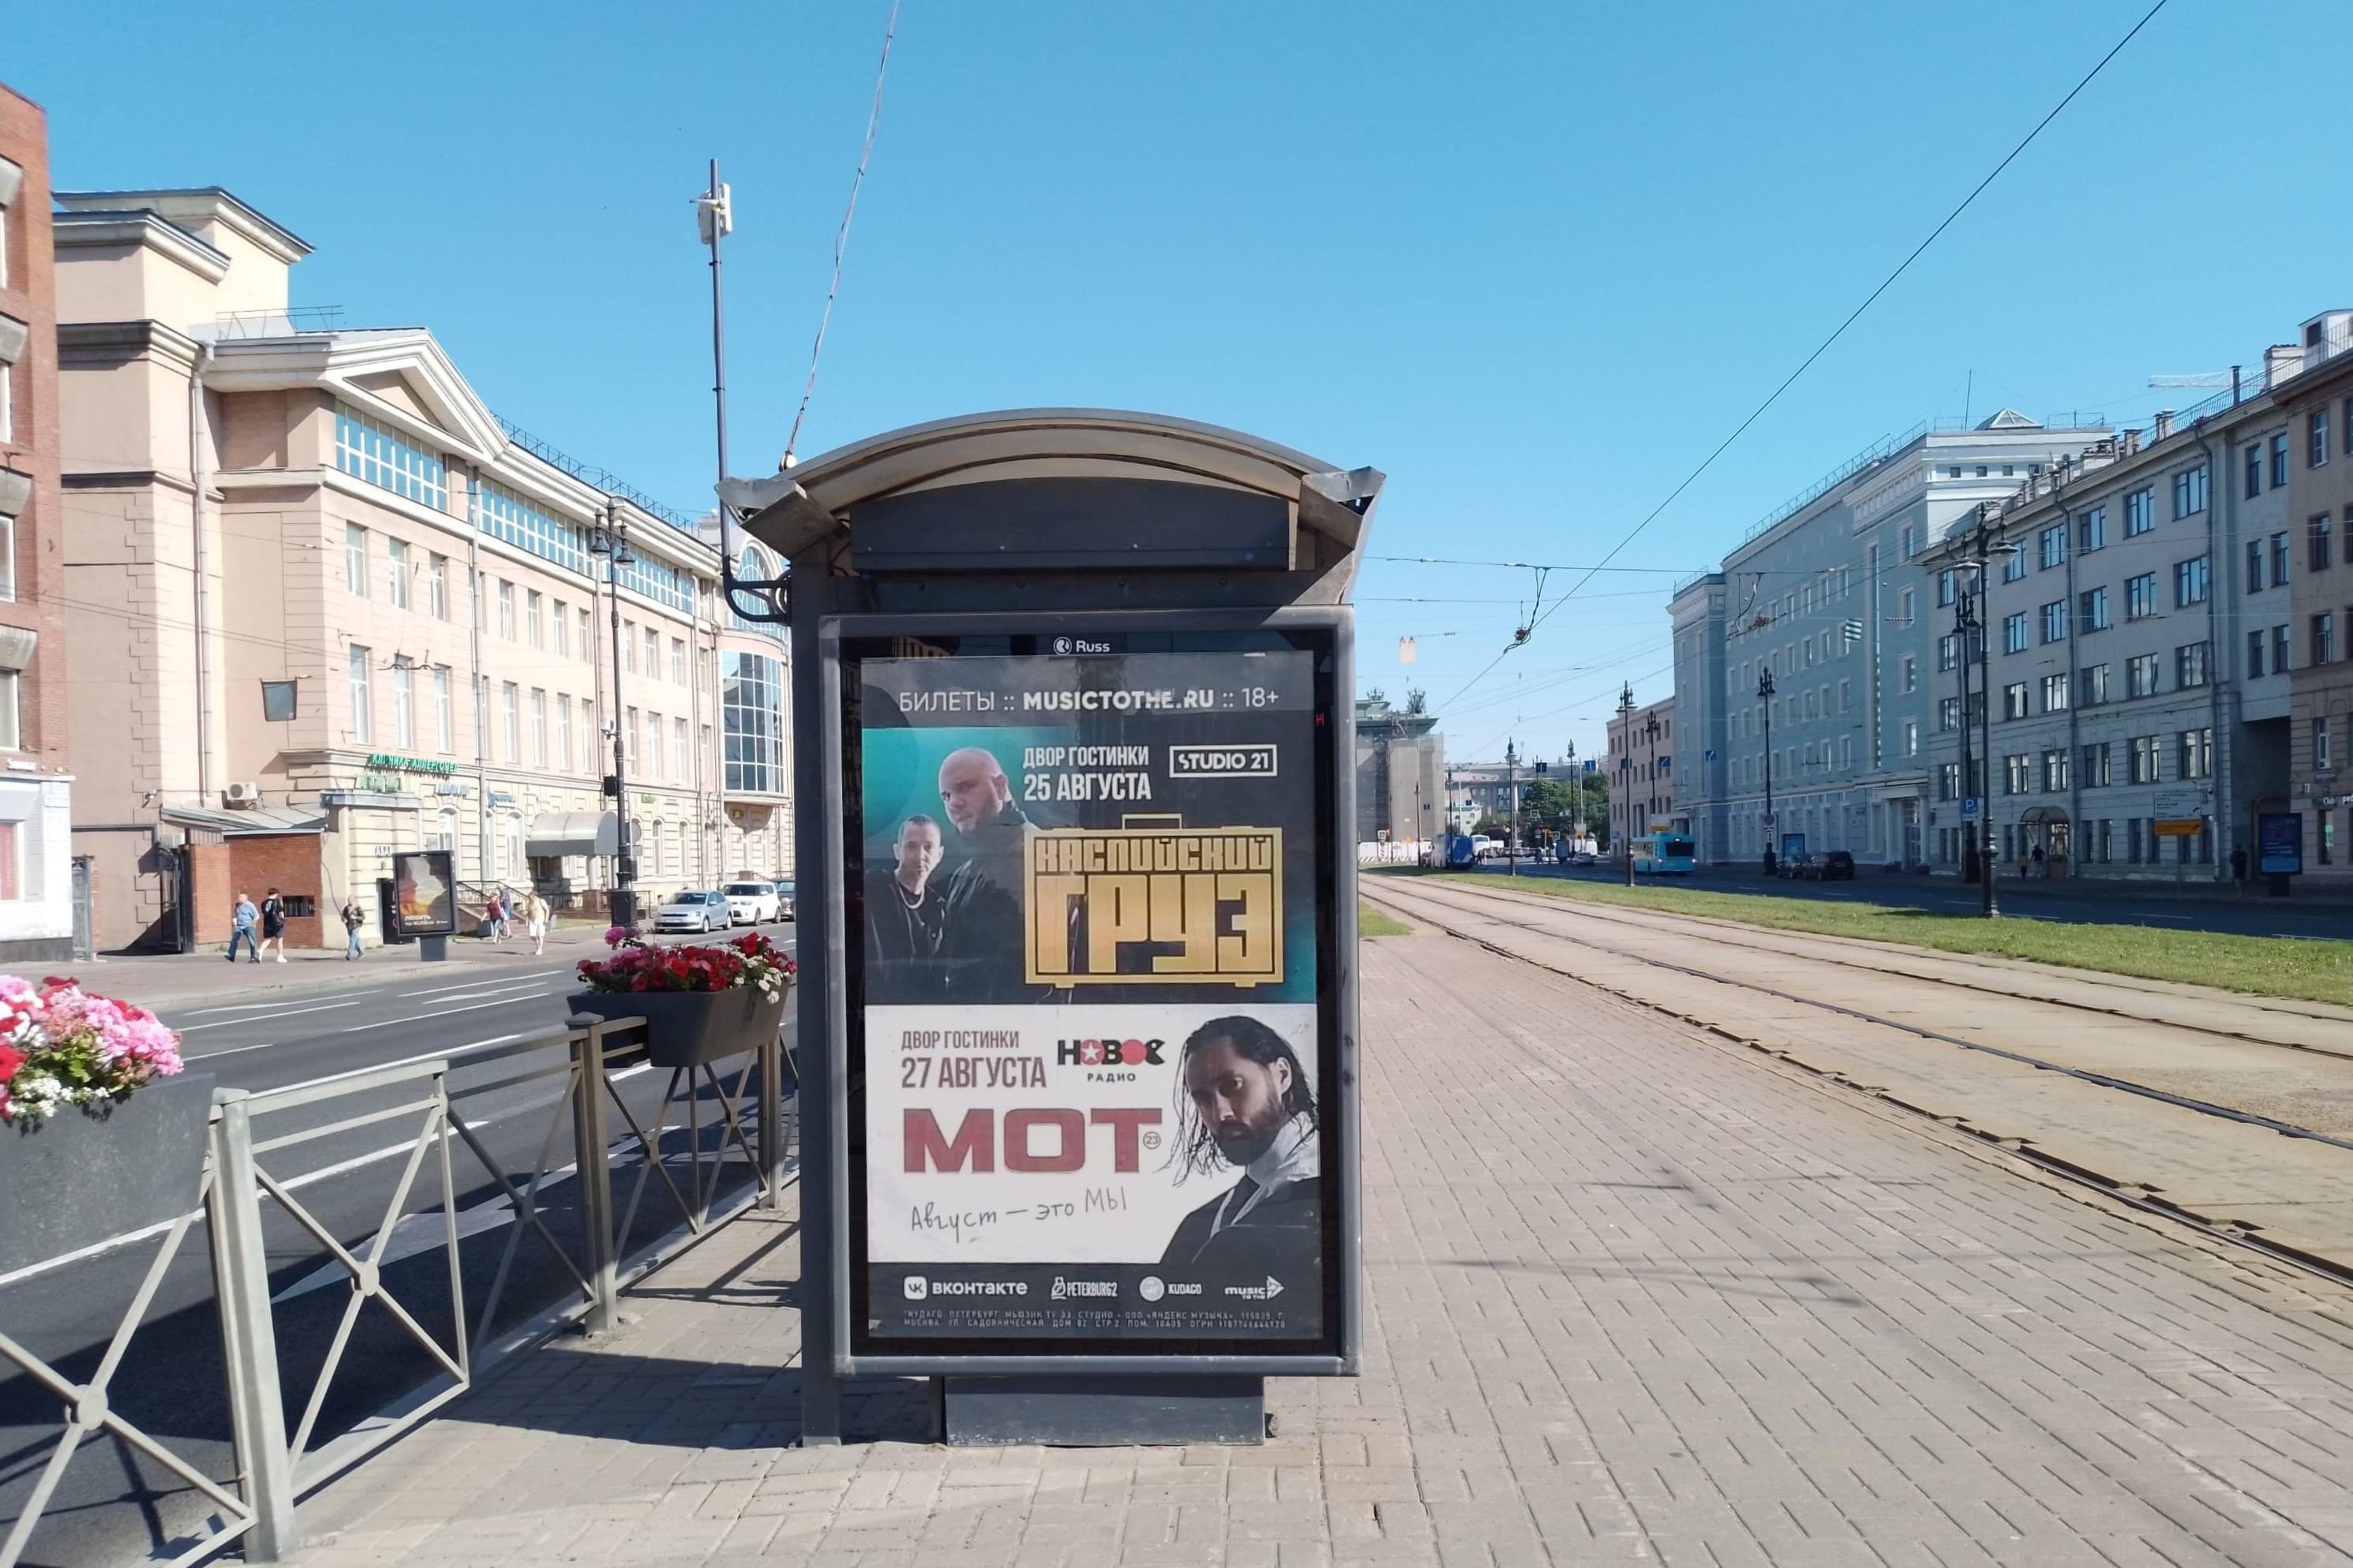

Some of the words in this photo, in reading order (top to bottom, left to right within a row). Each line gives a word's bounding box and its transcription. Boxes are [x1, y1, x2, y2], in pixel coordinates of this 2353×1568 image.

[1076, 640, 1111, 653] Russ
[899, 691, 995, 712] БИЛЕТЫ
[1023, 688, 1214, 710] MUSICTOTHE.RU
[1242, 687, 1279, 708] 18+
[1022, 747, 1065, 769] ДВОР
[1069, 745, 1150, 767] ГОСТИНКИ
[1178, 753, 1246, 770] STUDIO
[1251, 752, 1268, 769] 21
[1023, 773, 1051, 801] 25
[1056, 773, 1152, 801] АВГУСТА
[1035, 836, 1272, 872] КАСПИЙСКИЙ
[1036, 873, 1273, 974] ГРУЗ
[901, 1031, 940, 1050] ДВОР
[944, 1030, 1020, 1049] ГОСТИНКИ
[901, 1057, 932, 1089] 27
[938, 1056, 1047, 1088] АВГУСТА
[1086, 1072, 1137, 1084] РАДИО
[903, 1107, 1163, 1173] МОТ
[911, 1201, 997, 1244] Август
[1035, 1203, 1075, 1221] это
[1224, 1286, 1266, 1296] music
